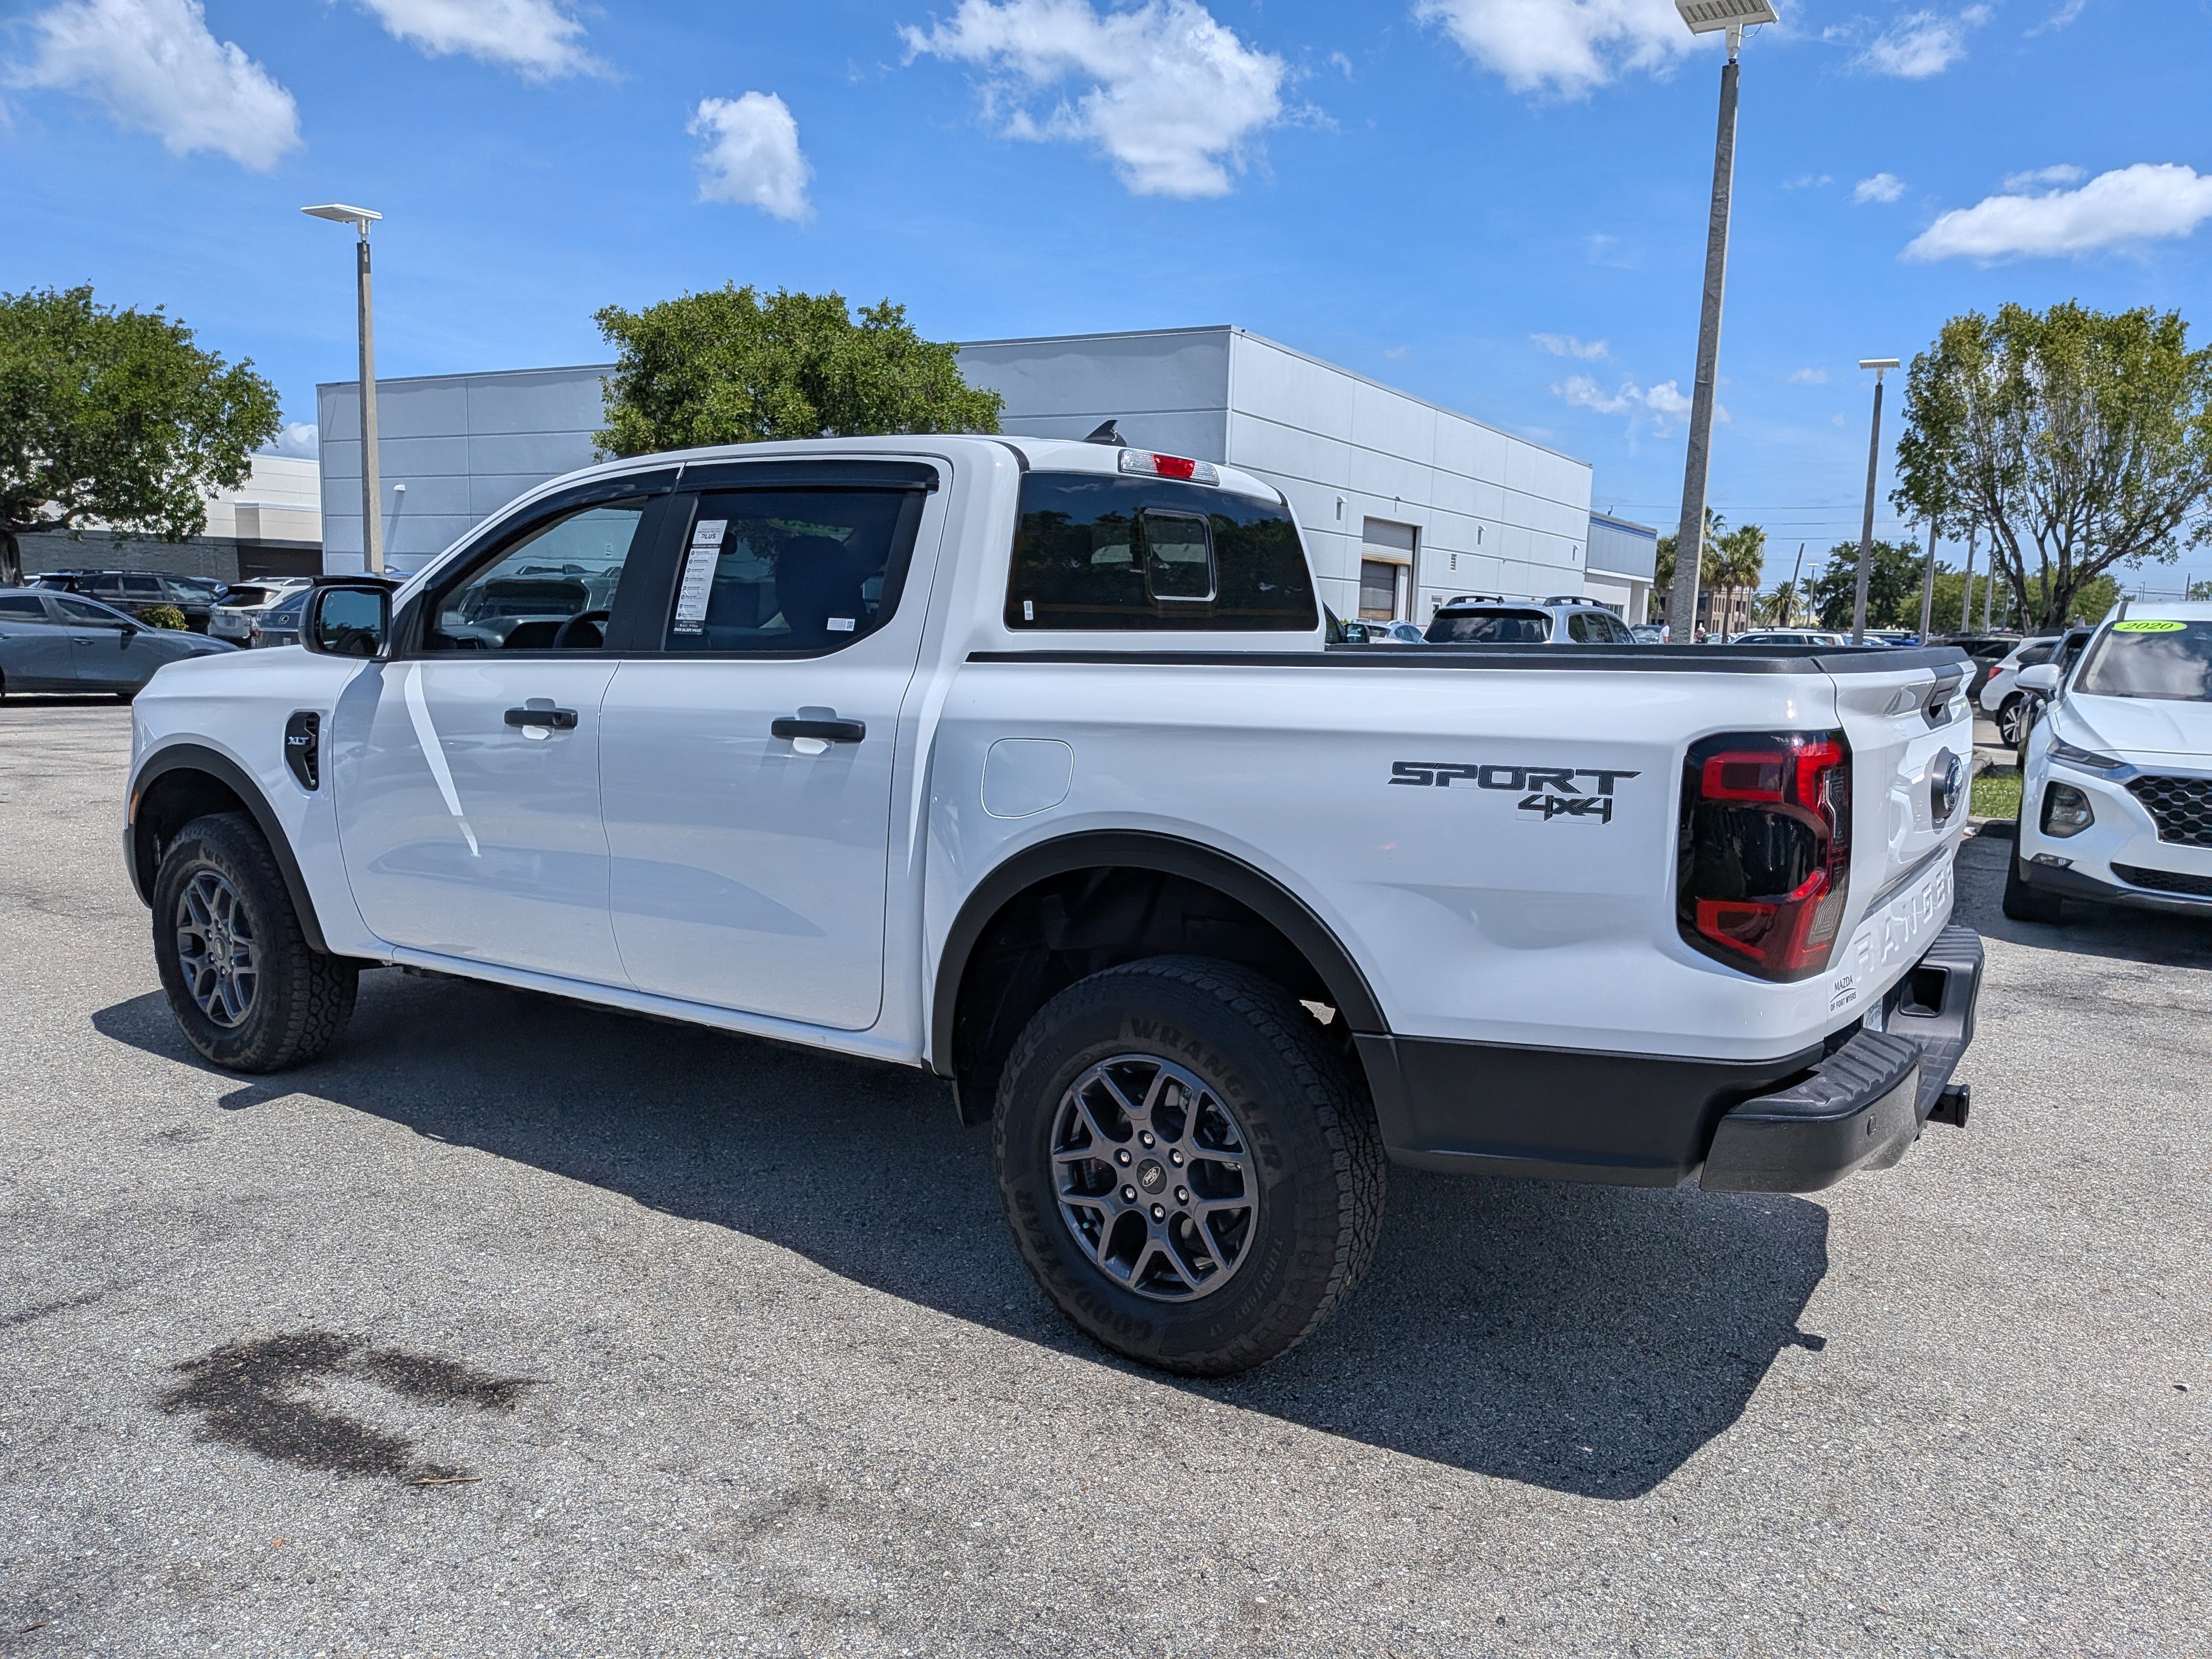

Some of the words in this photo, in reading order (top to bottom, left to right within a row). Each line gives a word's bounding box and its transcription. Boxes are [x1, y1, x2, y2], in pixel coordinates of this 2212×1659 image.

[288, 736, 310, 745] XLT
[1387, 761, 1642, 796] SPORT
[1517, 794, 1612, 825] 4x4
[1834, 974, 1853, 993] MAZDA
[1830, 1003, 1835, 1011] OF
[1836, 998, 1845, 1008] FORT
[1846, 993, 1856, 1004] MYERS
[1130, 1016, 1282, 1169] WRANGLER
[1144, 1168, 1157, 1184] Ford
